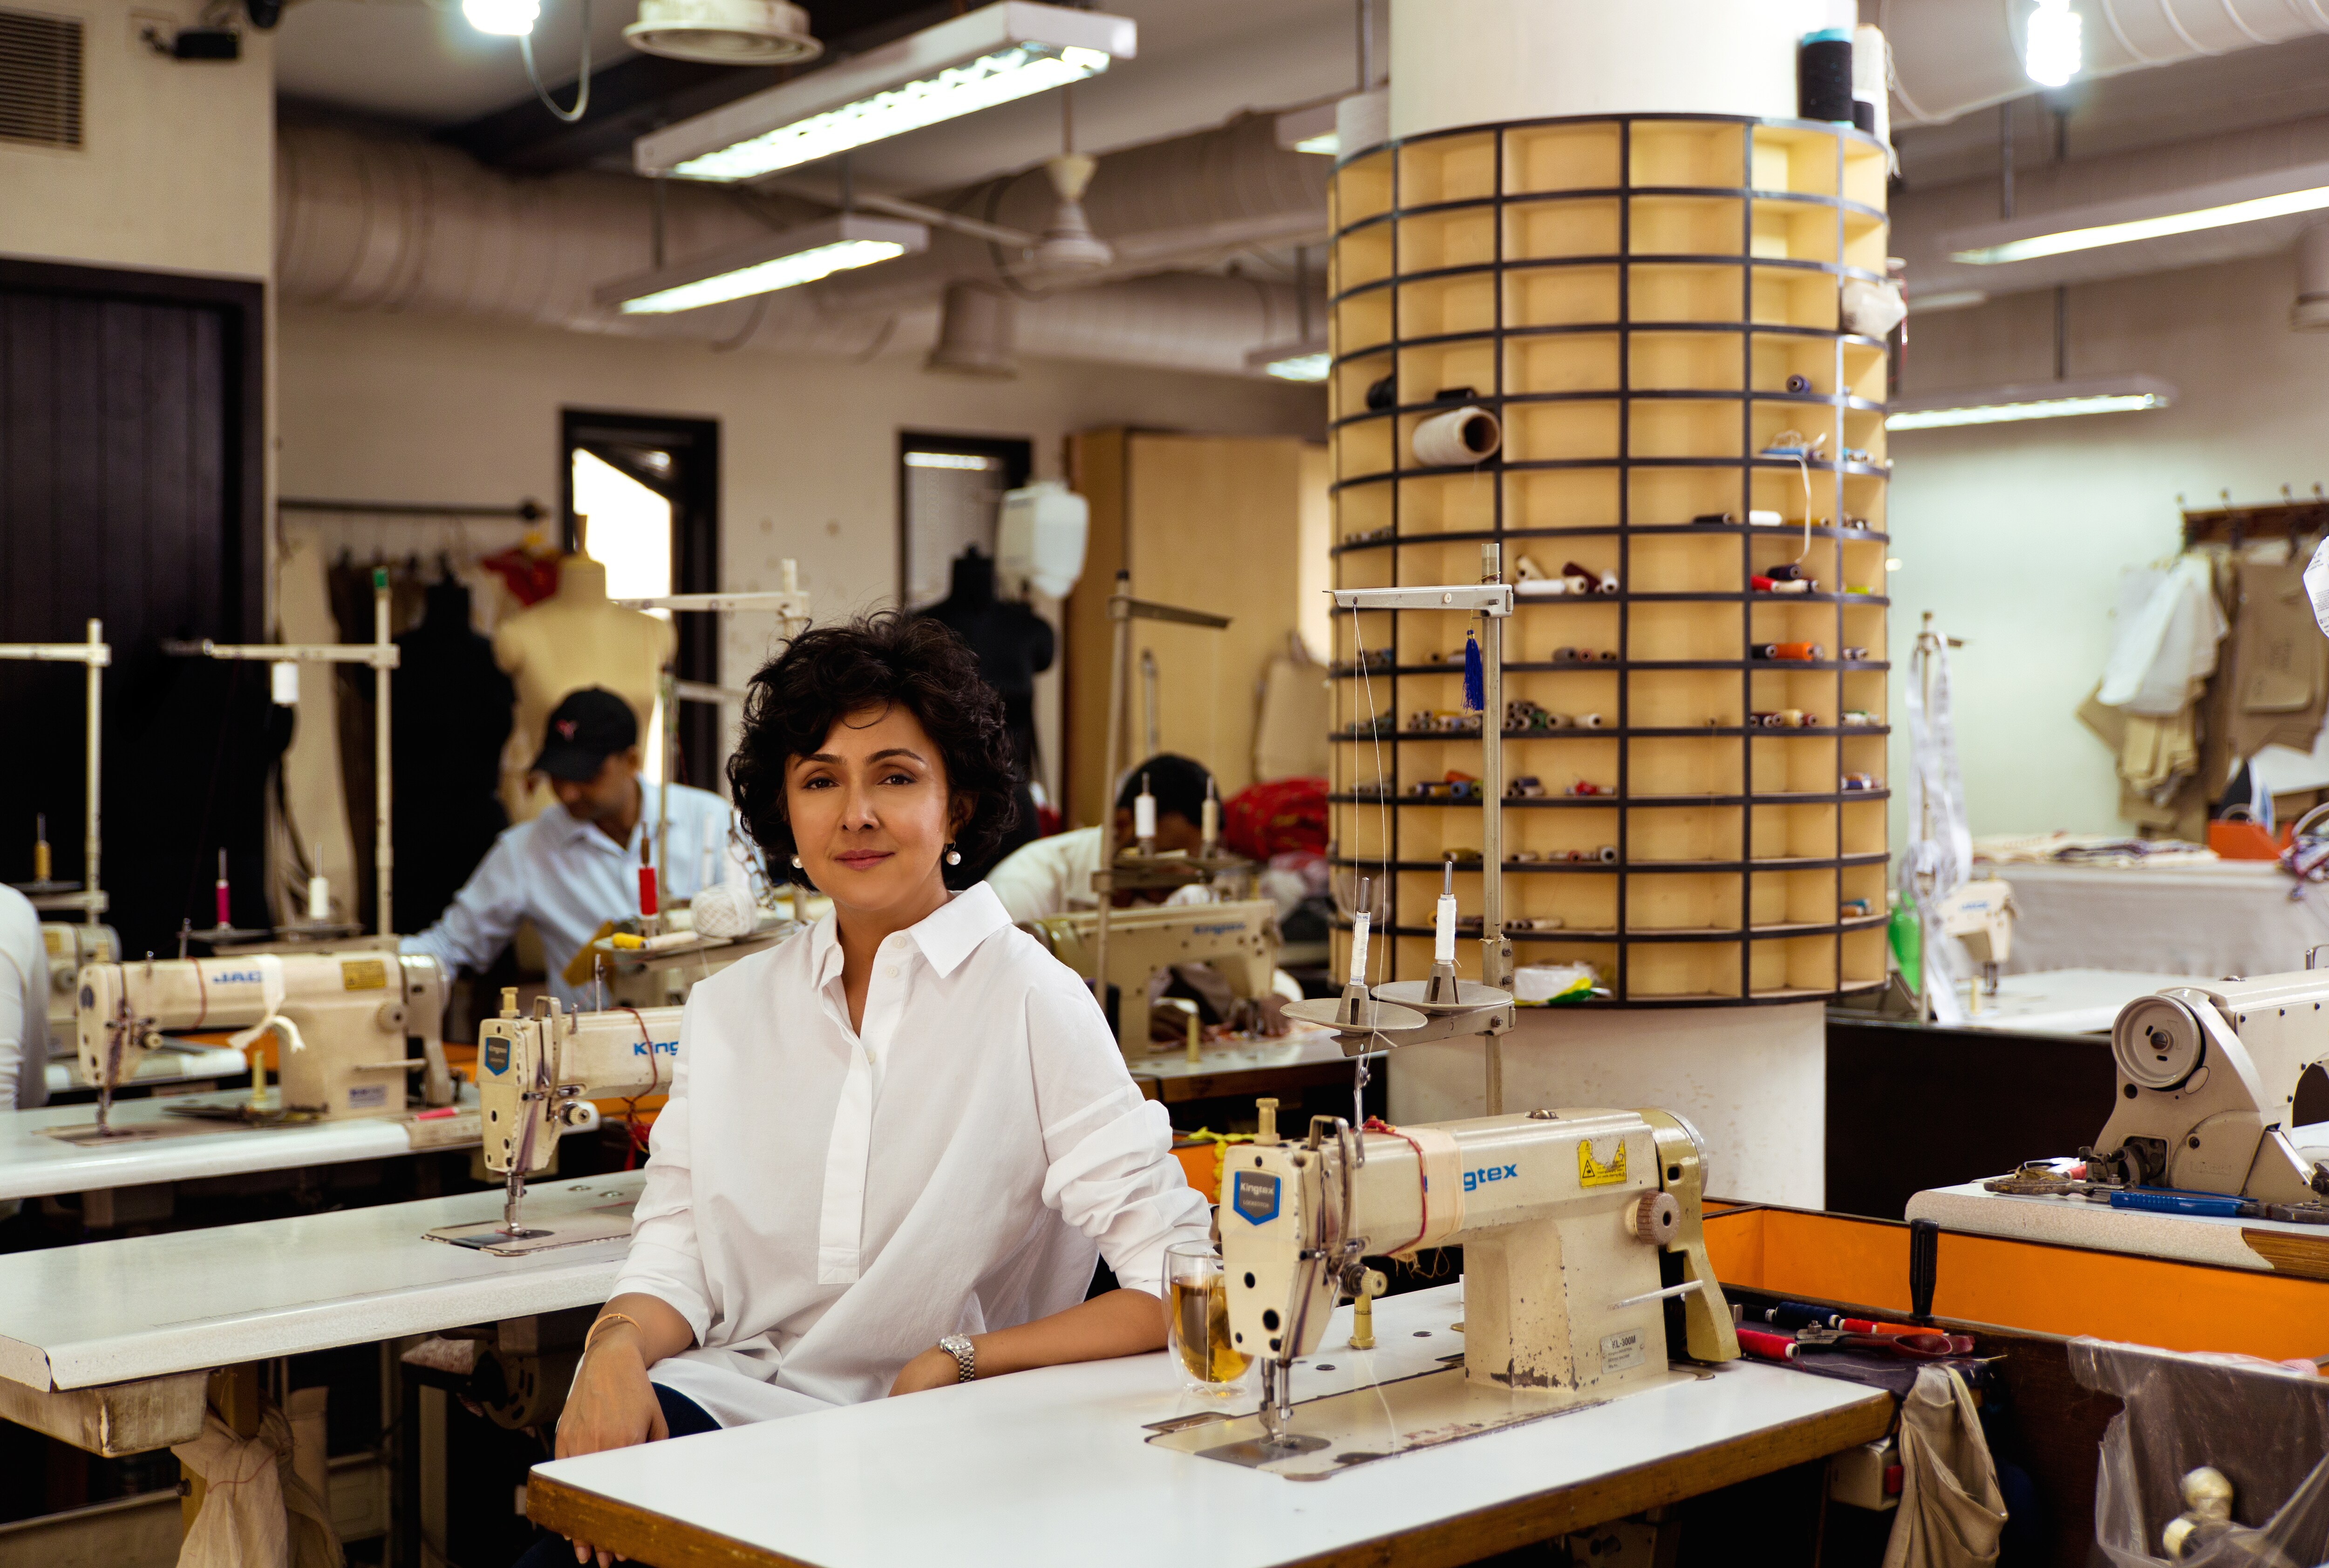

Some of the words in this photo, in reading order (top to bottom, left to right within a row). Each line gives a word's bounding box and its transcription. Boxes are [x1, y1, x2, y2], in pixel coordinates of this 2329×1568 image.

[634, 1041, 679, 1056] King
[1463, 1163, 1518, 1192] gtex
[1240, 1182, 1274, 1195] Kingtex
[1612, 1335, 1636, 1349] KL-300M
